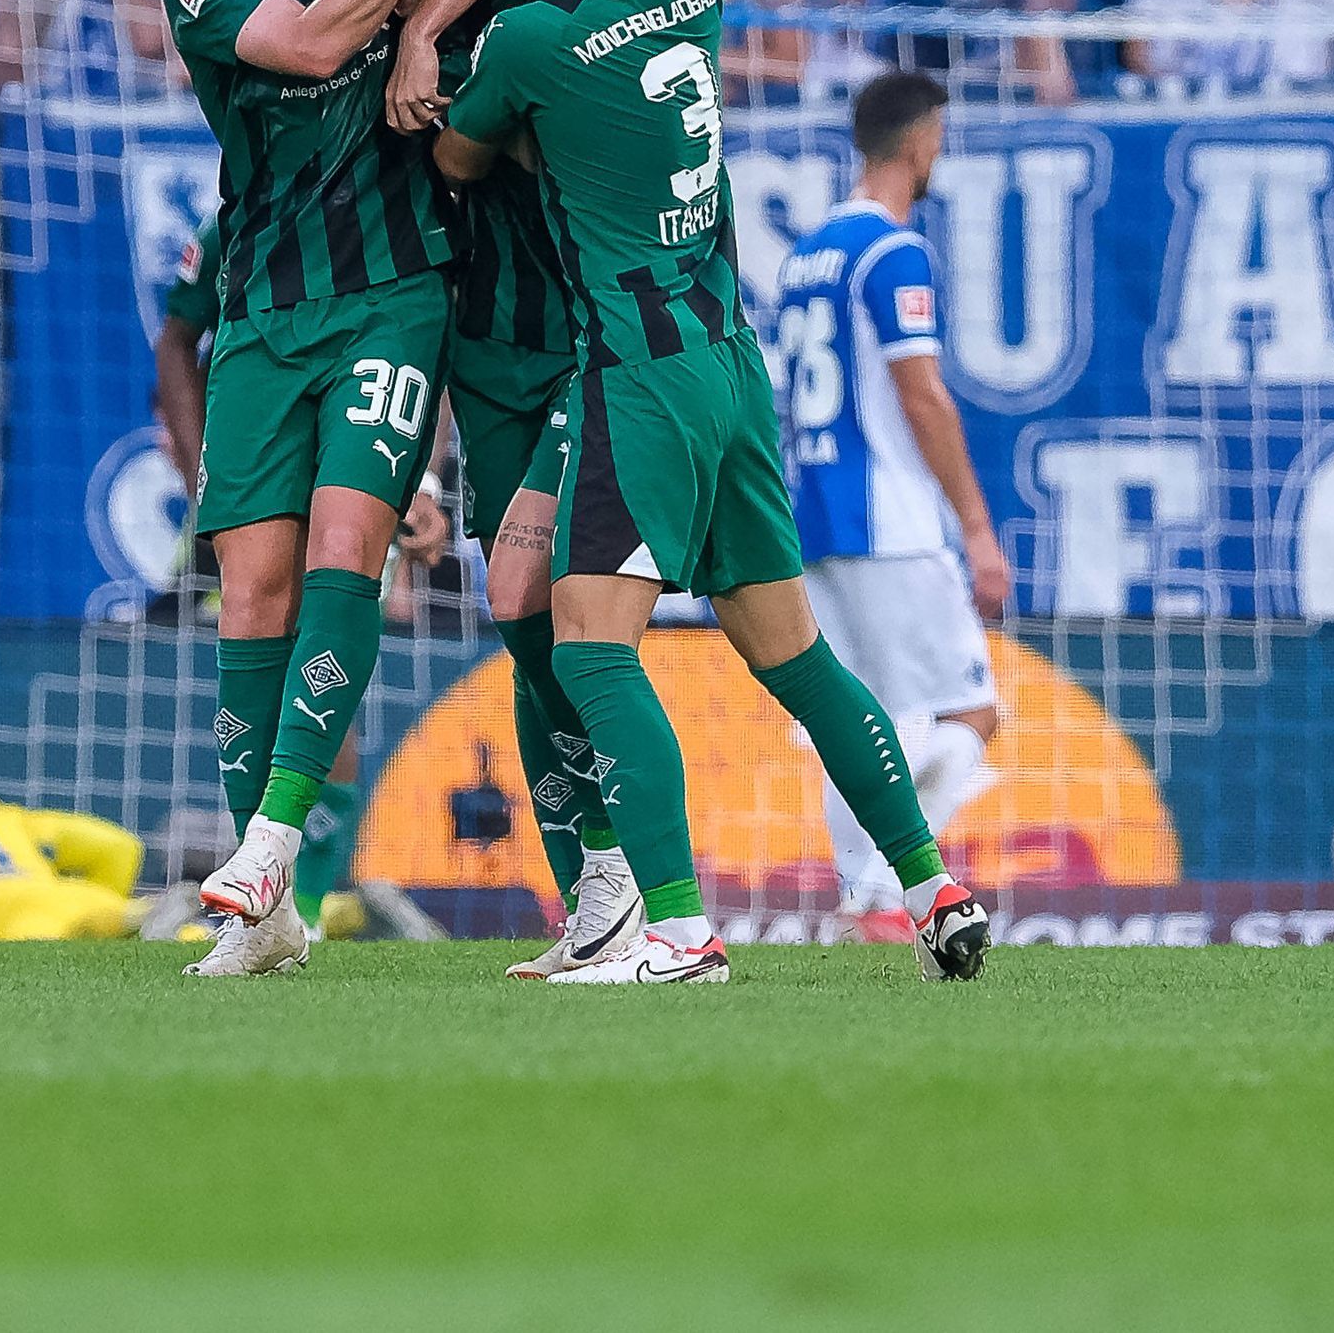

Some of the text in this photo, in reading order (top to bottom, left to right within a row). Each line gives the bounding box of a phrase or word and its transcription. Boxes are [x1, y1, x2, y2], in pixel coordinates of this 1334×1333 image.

[280, 84, 329, 100] Anlegn
[329, 73, 350, 90] bei
[640, 41, 723, 204] 3
[658, 192, 719, 246] ITAKU
[346, 358, 429, 440] 30
